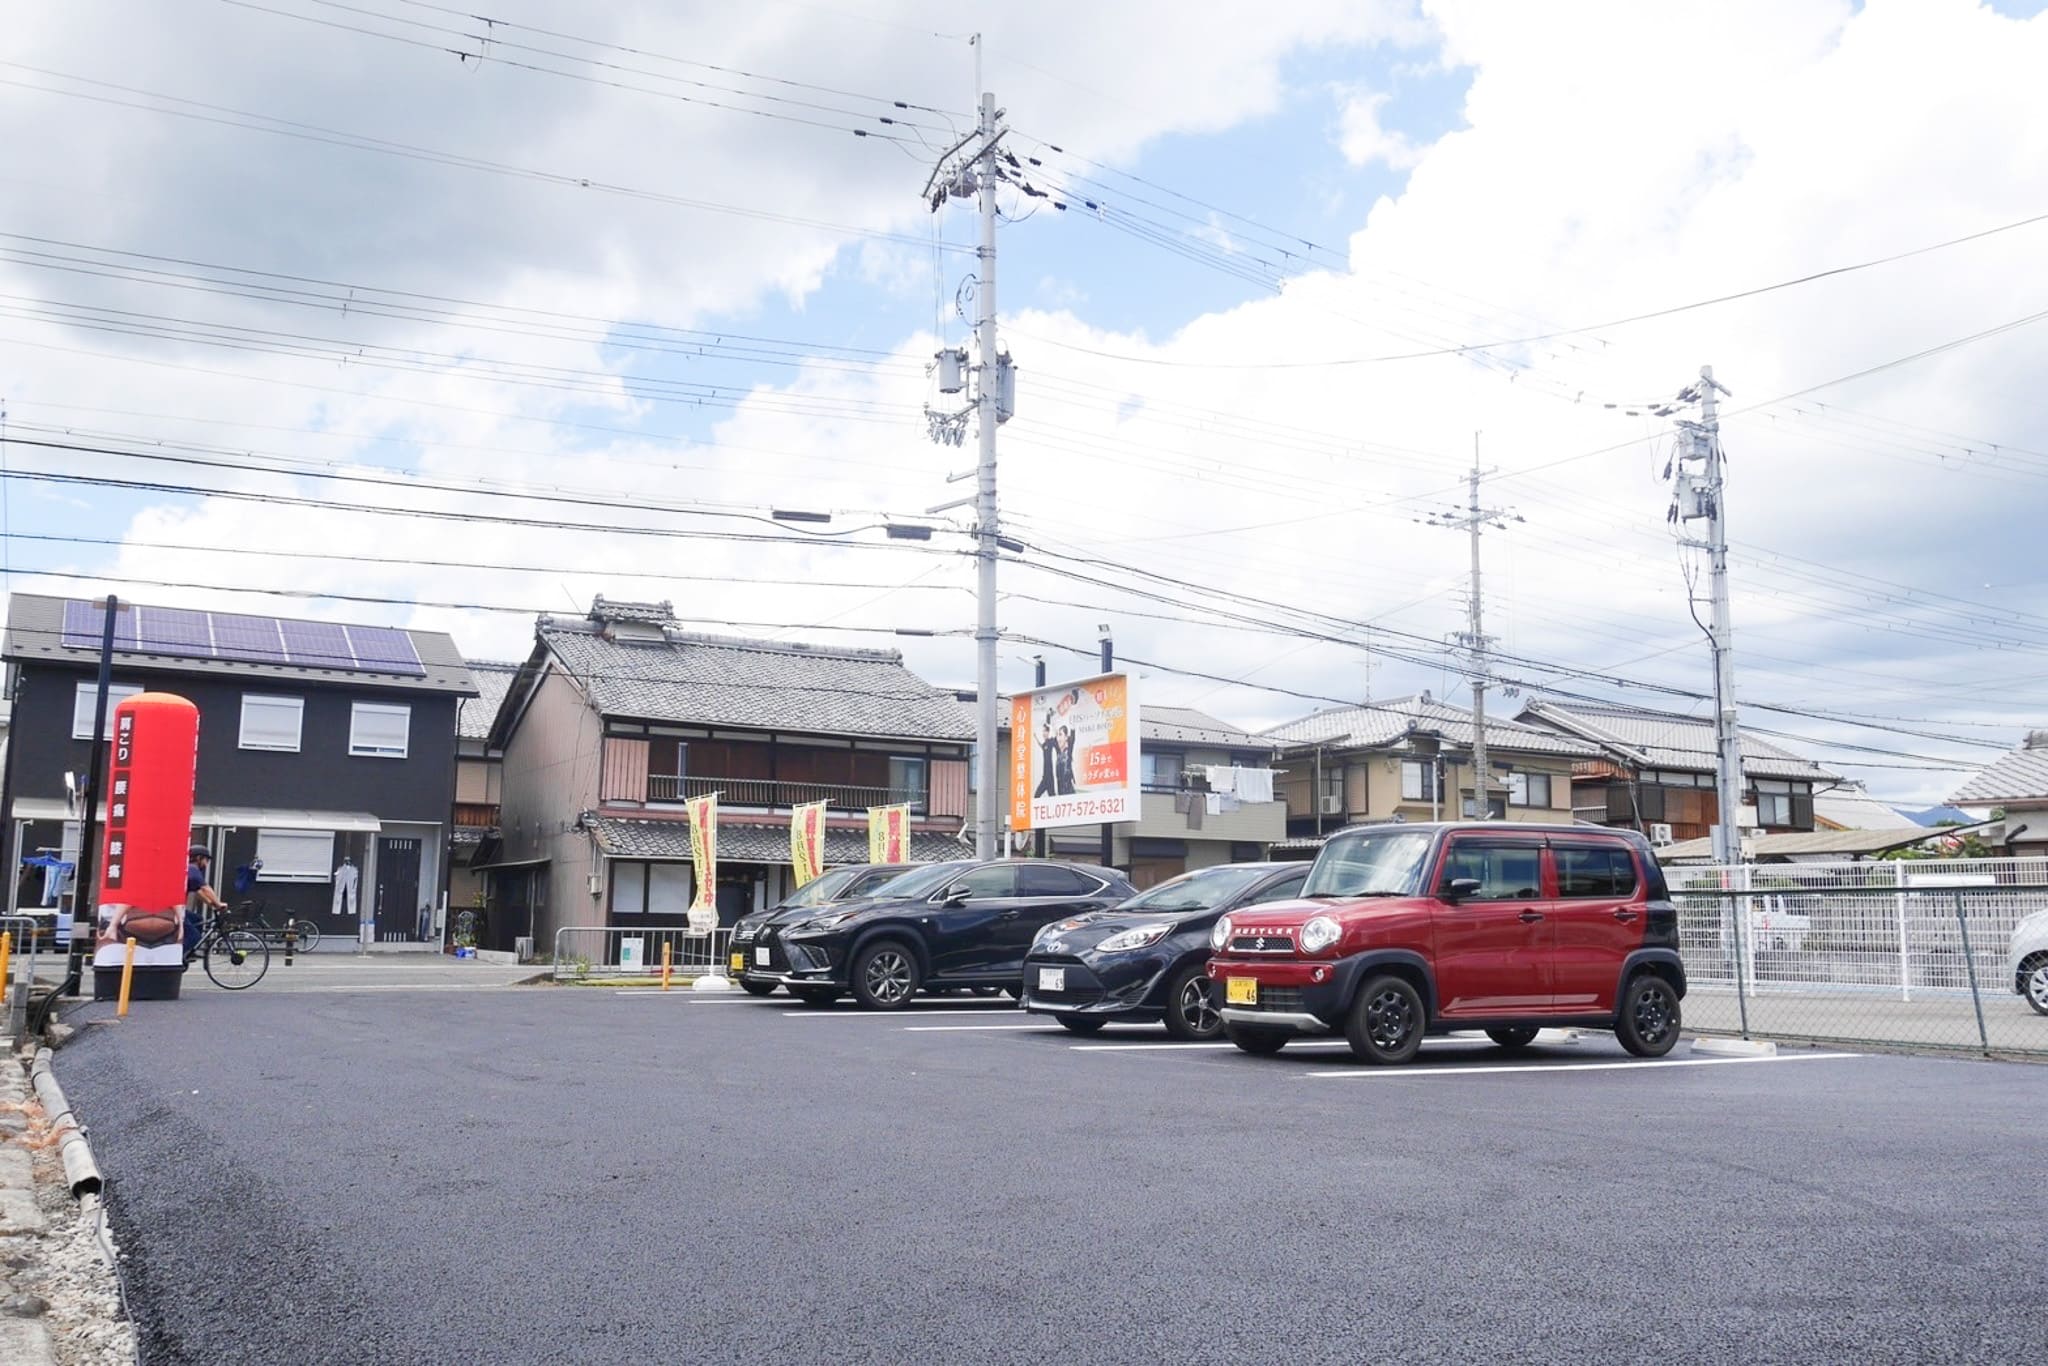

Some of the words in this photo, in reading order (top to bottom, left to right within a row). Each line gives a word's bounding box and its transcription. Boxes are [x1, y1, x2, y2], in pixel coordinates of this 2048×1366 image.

[118, 716, 132, 761] 肩こり
[113, 780, 127, 817] 腰痛
[1033, 797, 1125, 820] TEL.077-572-6321
[107, 841, 122, 878] 膝痛
[1235, 927, 1294, 935] HUSTLER
